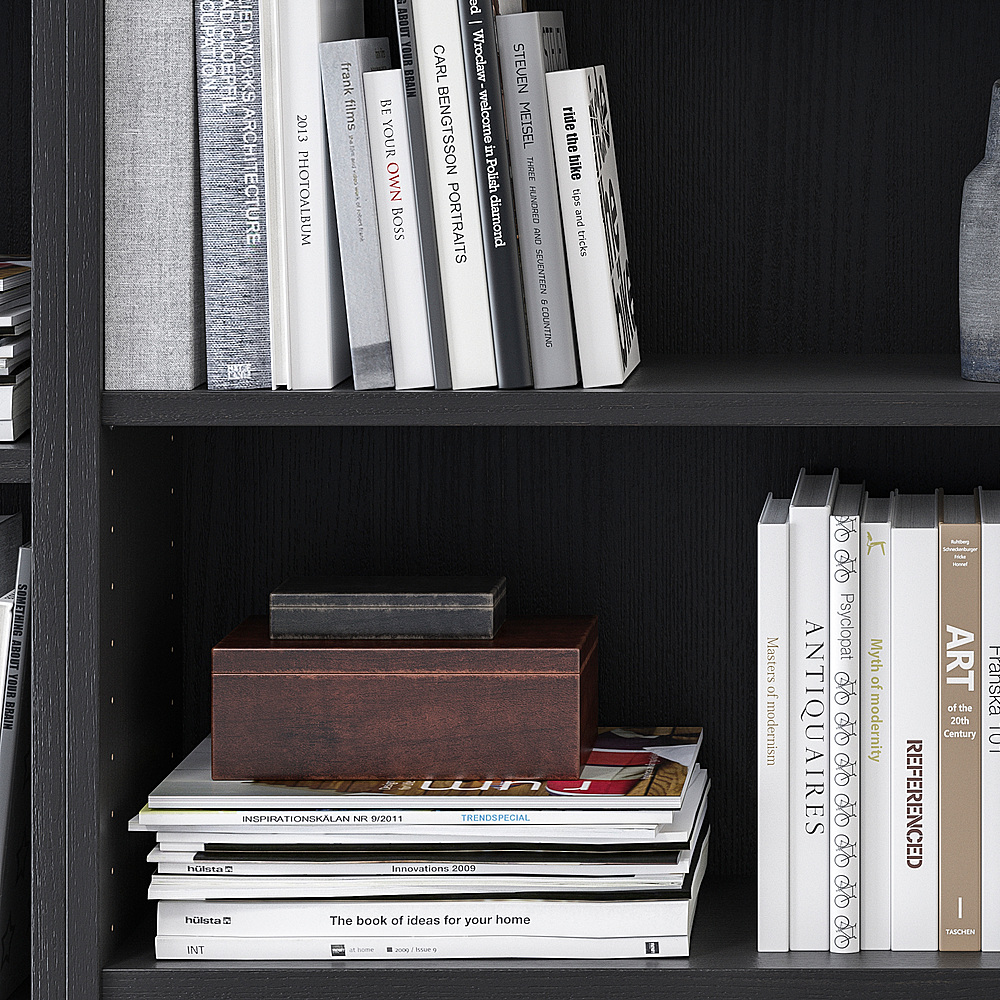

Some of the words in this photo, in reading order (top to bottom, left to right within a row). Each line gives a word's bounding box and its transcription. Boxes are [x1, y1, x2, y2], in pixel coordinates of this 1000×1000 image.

[399, 7, 411, 38] ABOUT
[402, 41, 414, 67] YOUR
[433, 44, 449, 83] CARL
[472, 29, 488, 82] Wroclaw
[513, 43, 529, 93] STEVEN
[241, 39, 256, 102] WORKS
[340, 62, 355, 96] frank
[404, 69, 417, 98] BRAIN
[297, 114, 308, 142] 2013
[344, 99, 357, 131] films
[437, 86, 458, 175] BENGTSSON
[479, 89, 495, 143] welcome
[518, 102, 534, 149] MEISEL
[562, 106, 576, 131] ride
[383, 119, 396, 159] YOUR
[485, 145, 497, 157] in
[566, 133, 578, 152] the
[242, 108, 260, 246] ARCHITECTURE
[386, 162, 402, 202] OWN
[486, 158, 501, 193] Polish
[526, 156, 536, 182] THREE
[567, 152, 581, 181] bike
[298, 151, 312, 246] PHOTOALBUM
[529, 186, 540, 224] HUNDRED
[571, 188, 581, 209] tips
[447, 183, 467, 264] PORTRAITS
[490, 195, 506, 248] diamond
[575, 210, 584, 230] and
[533, 228, 542, 245] AND
[577, 231, 587, 258] tricks
[535, 249, 547, 295] SEVENTEEN
[13, 583, 28, 637] SOMETHING
[837, 593, 855, 661] Psyclopat
[9, 639, 22, 671] ABOUT
[766, 637, 779, 683] Masters
[867, 638, 883, 673] Myth
[946, 624, 975, 691] ART
[6, 673, 19, 698] YOUR
[766, 686, 779, 699] of
[870, 676, 883, 691] of
[3, 701, 15, 730] BRAIN
[947, 703, 957, 712] of
[958, 703, 973, 712] the
[950, 716, 970, 725] 20th
[766, 701, 779, 767] modernism
[800, 619, 825, 836] ANTIQUAIRES
[867, 693, 883, 763] modernity
[943, 729, 977, 740] Century
[353, 815, 369, 823] NR
[371, 815, 404, 824] 9/2011
[461, 814, 531, 822] TRENDSPECIAL
[906, 739, 923, 869] REFERENCED
[187, 865, 223, 873] hülsta
[391, 865, 450, 873] Innovations
[451, 864, 476, 873] 2009
[185, 916, 222, 925] hülsta
[330, 915, 353, 926] The
[356, 915, 388, 926] book
[391, 915, 404, 926] of
[407, 915, 440, 926] ideas
[443, 914, 462, 925] for
[464, 916, 493, 927] your
[496, 914, 531, 925] home
[187, 945, 205, 955] INT
